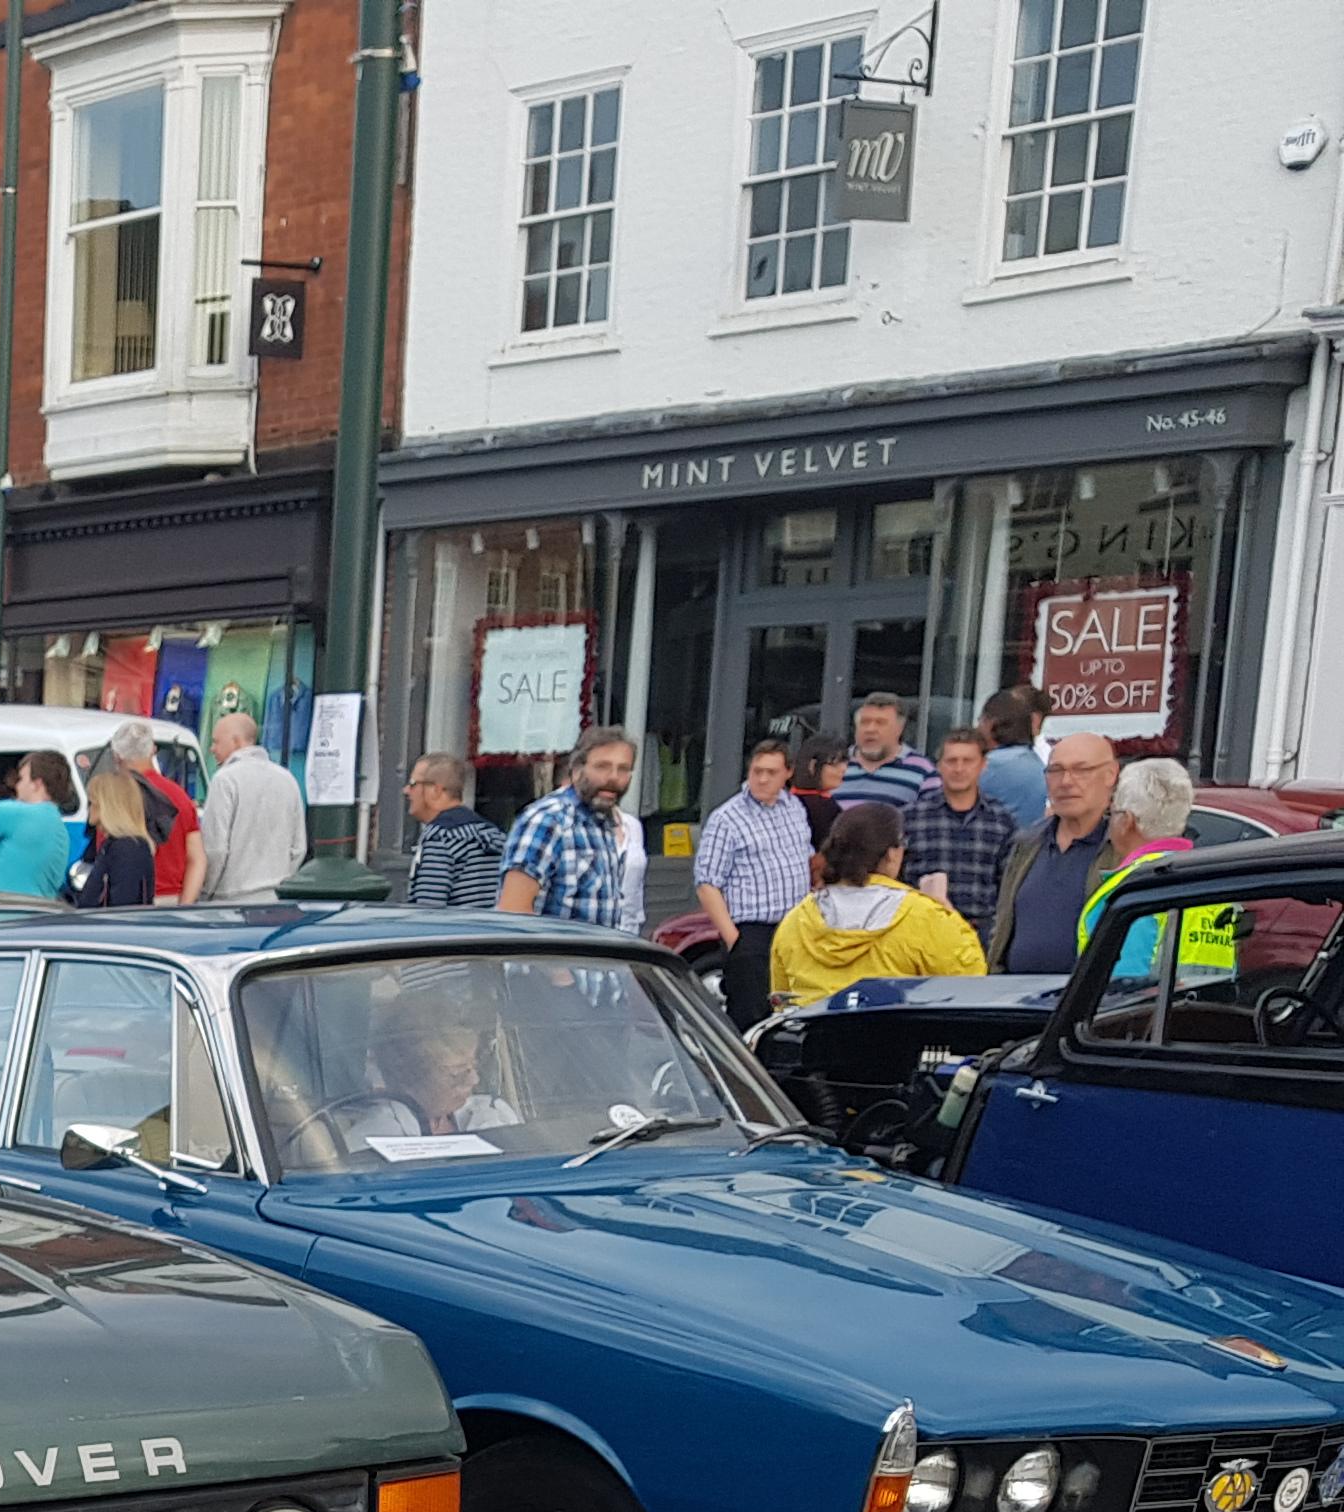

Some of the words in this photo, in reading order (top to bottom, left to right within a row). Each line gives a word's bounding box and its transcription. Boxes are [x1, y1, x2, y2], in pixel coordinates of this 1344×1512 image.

[1179, 407, 1227, 430] 45-46
[642, 456, 737, 489] MINT
[754, 437, 898, 479] VELVET
[1050, 604, 1166, 655] SALE
[497, 669, 568, 704] SALE
[1048, 683, 1097, 711] 50%
[1104, 680, 1157, 708] OFF
